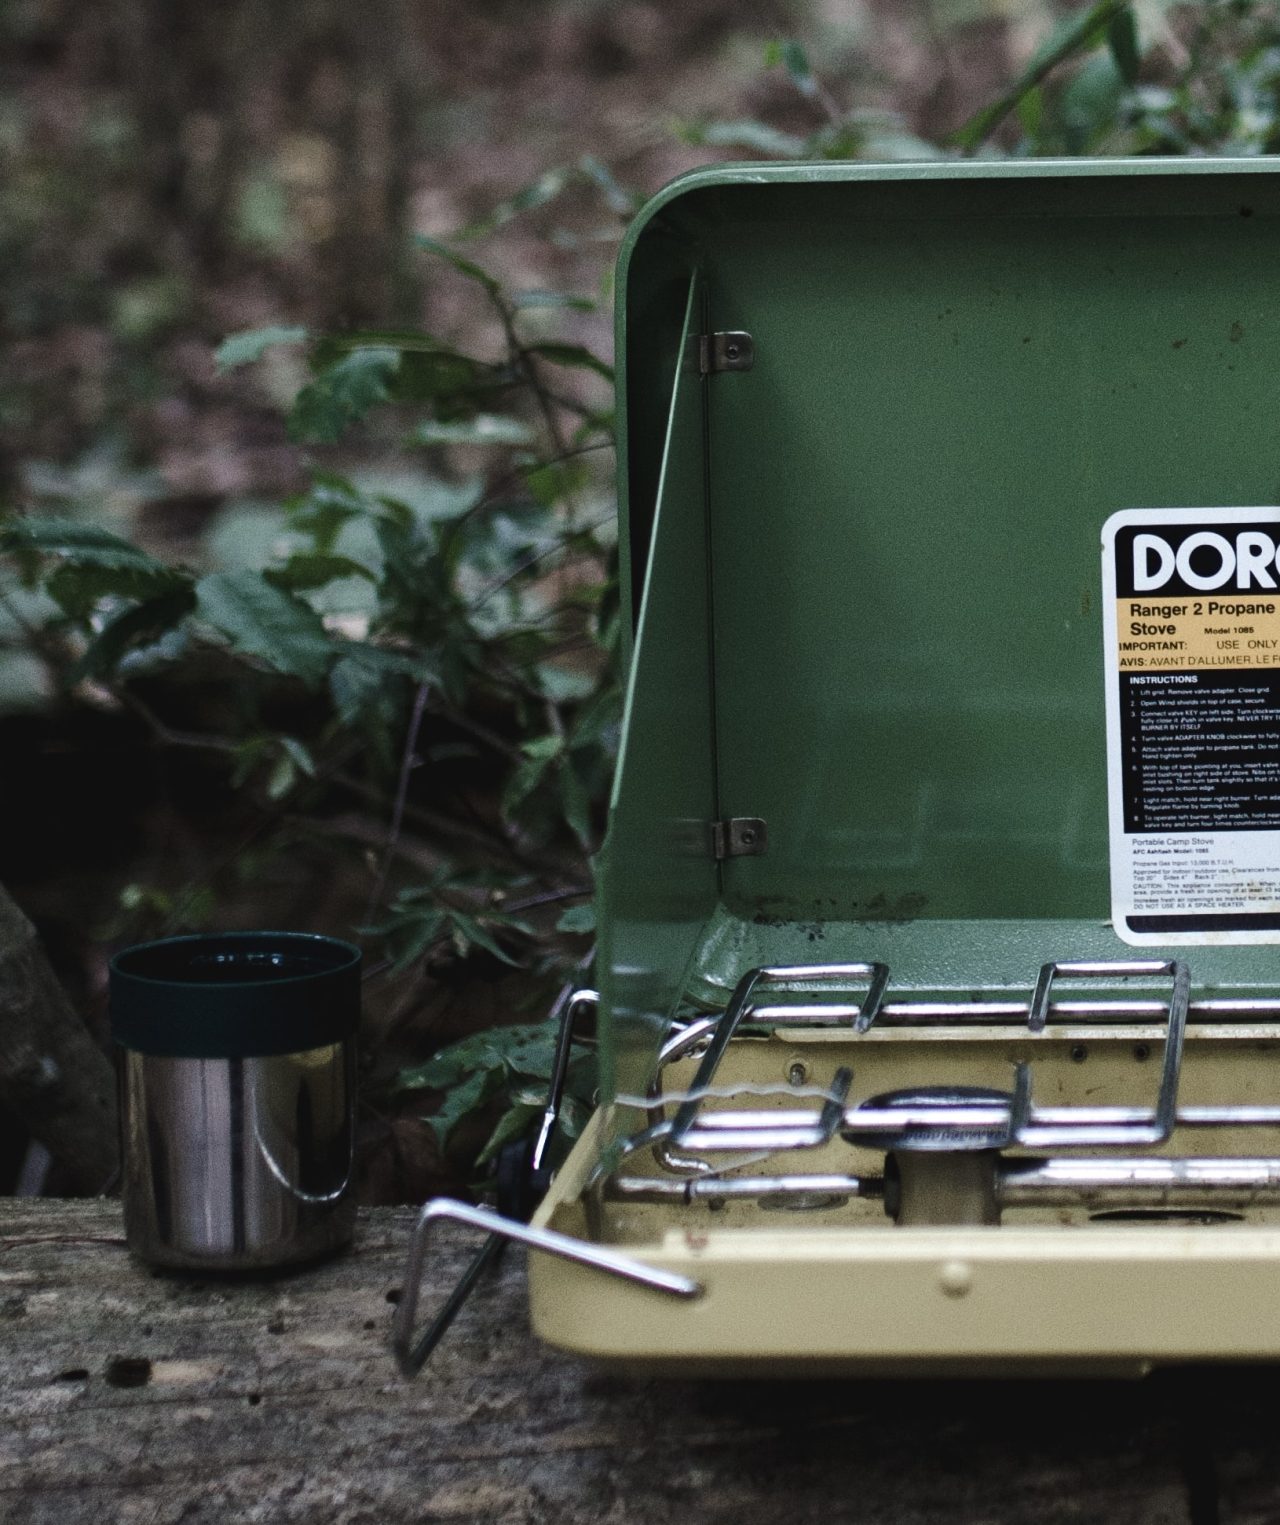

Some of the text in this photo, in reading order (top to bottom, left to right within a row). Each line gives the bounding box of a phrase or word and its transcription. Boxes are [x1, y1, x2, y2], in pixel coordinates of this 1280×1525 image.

[1130, 601, 1275, 618] Ranger 2 Propane
[1130, 621, 1176, 635] Stove
[1118, 640, 1186, 650] IMPORTANT:
[1216, 640, 1238, 649] USE
[1247, 639, 1277, 648] ONLY
[1119, 657, 1146, 666] AVIS:
[1149, 656, 1184, 665] AVANT
[1256, 654, 1268, 663] LE
[1129, 675, 1197, 684] INSTRUCTIONS
